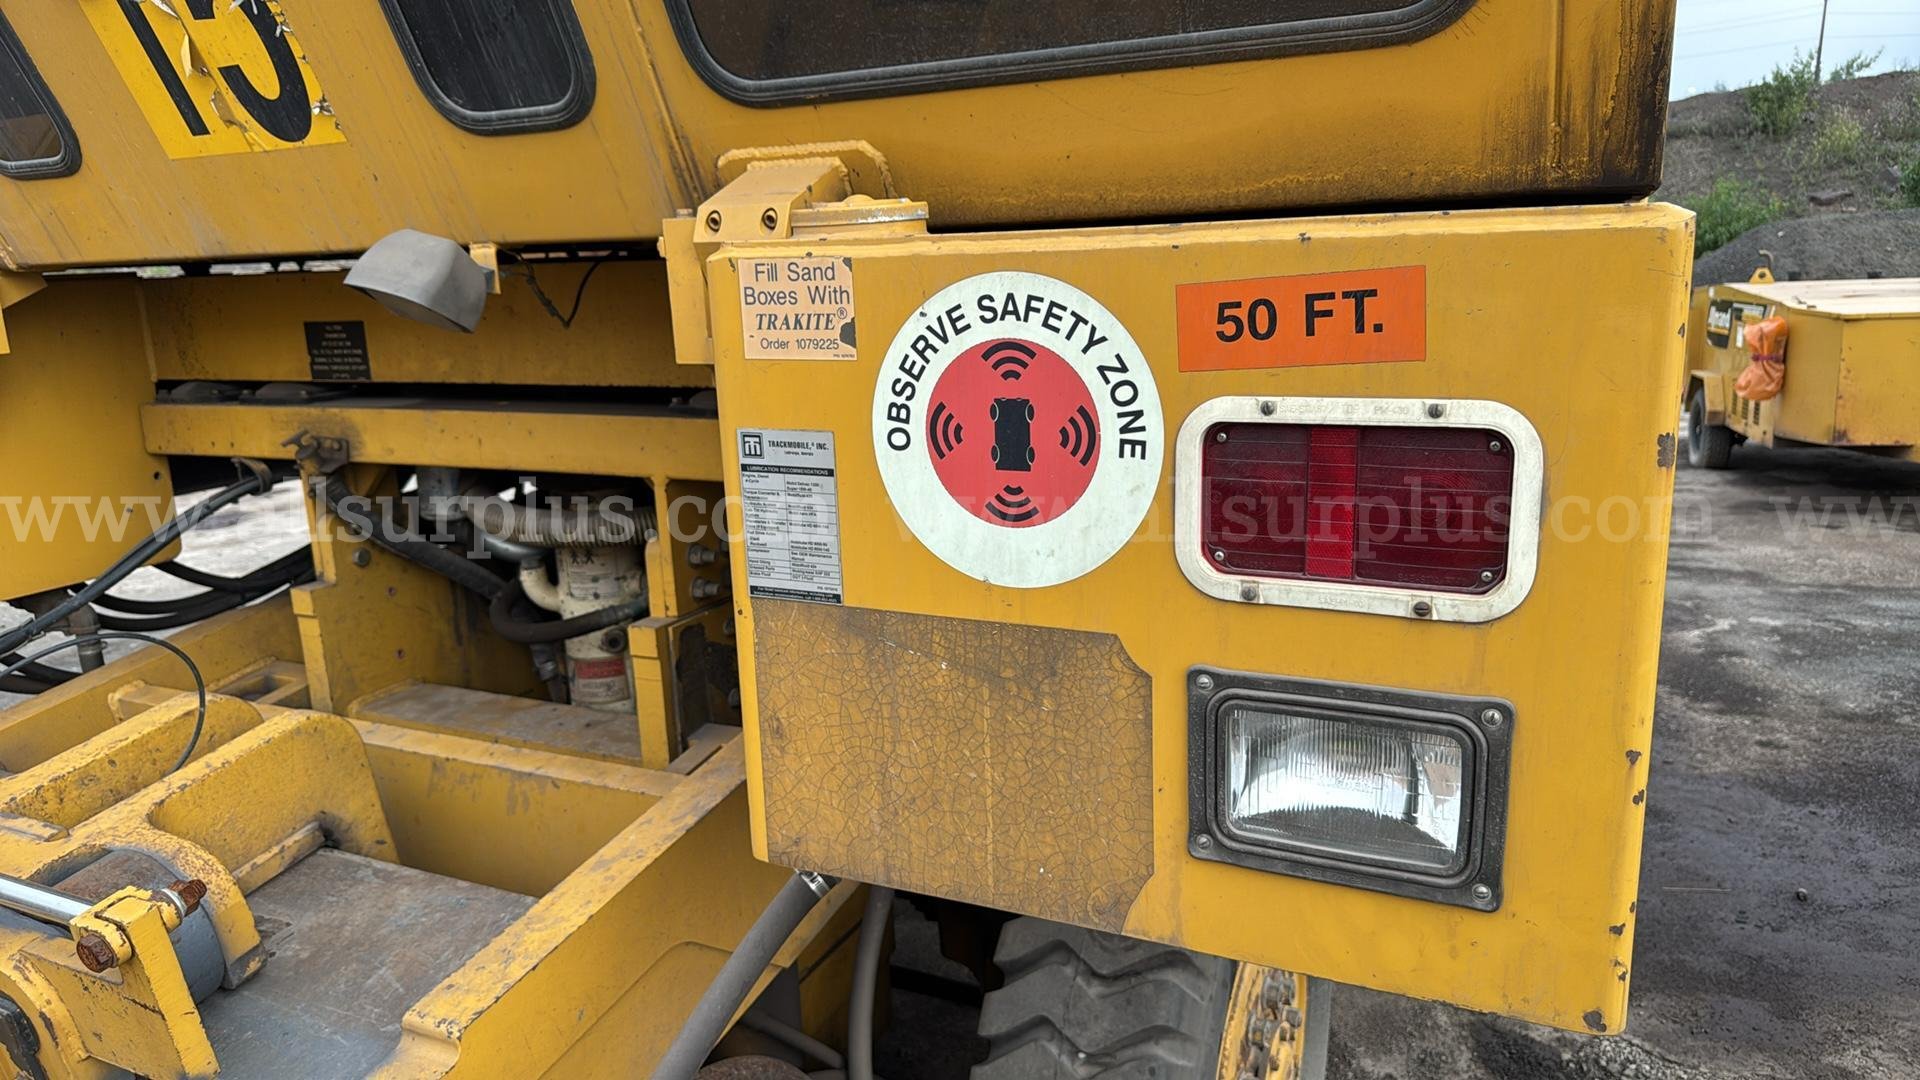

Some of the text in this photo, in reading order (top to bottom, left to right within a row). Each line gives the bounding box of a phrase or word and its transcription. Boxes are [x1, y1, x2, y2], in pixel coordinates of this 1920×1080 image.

[755, 261, 835, 282] Fill Sand
[744, 285, 850, 305] Boxes With
[1216, 289, 1383, 342] 50 FT.
[760, 338, 840, 350] Order 1079225
[887, 292, 1147, 460] OBSERVE SAFETY ZONE
[816, 442, 829, 450] INC.
